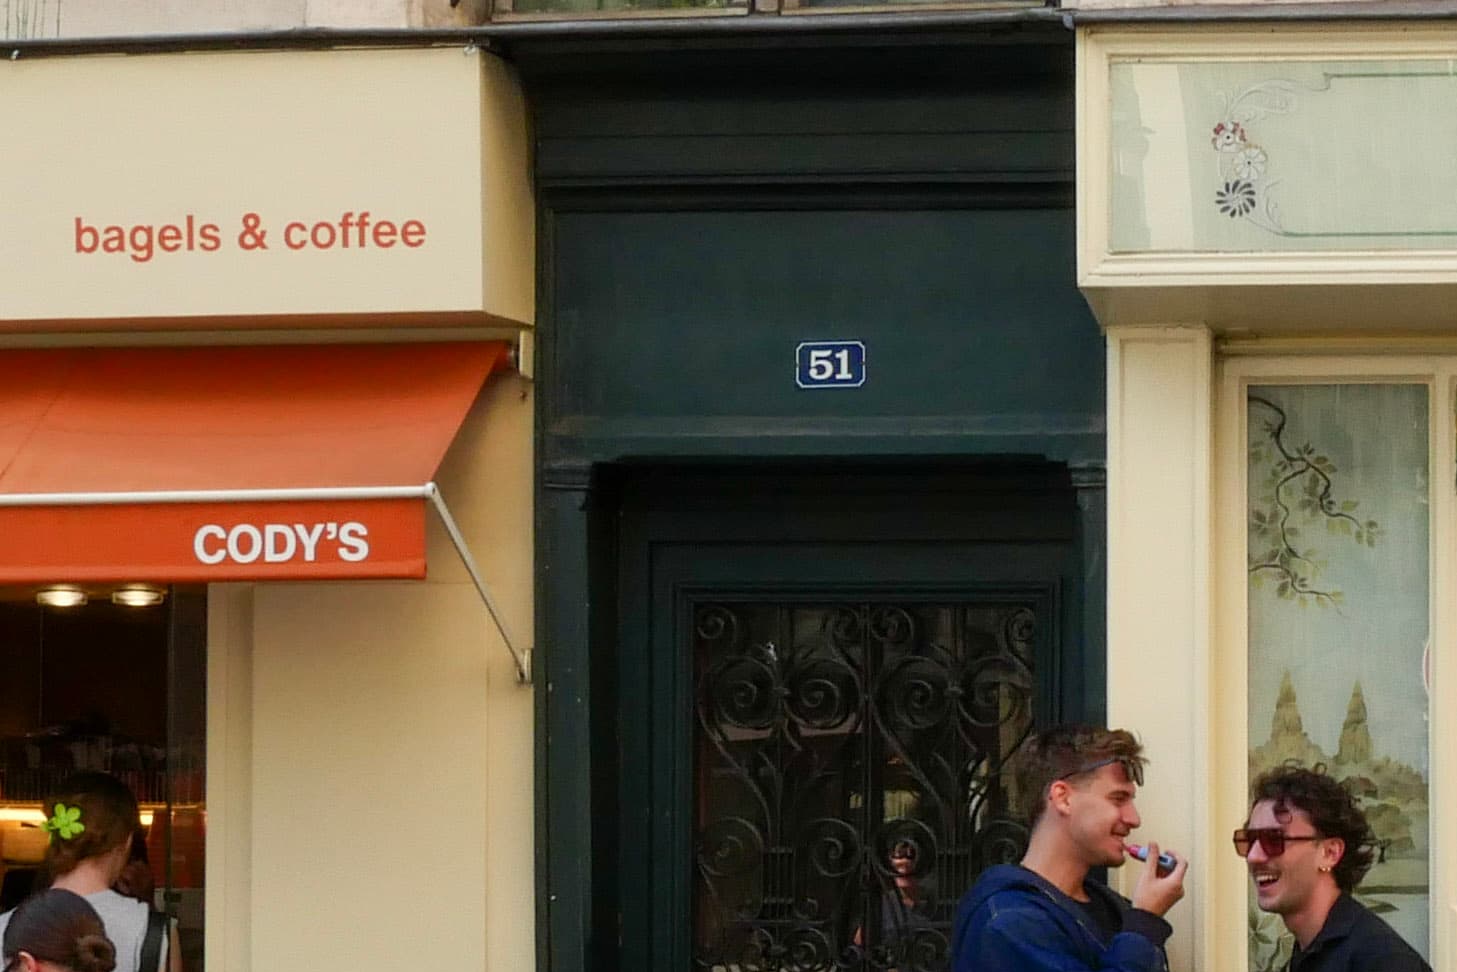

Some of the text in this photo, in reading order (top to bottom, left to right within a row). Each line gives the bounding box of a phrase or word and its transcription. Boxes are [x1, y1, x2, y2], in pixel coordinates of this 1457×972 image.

[74, 210, 427, 263] bagels & coffee
[808, 348, 853, 381] 51
[193, 521, 370, 565] CODY'S
